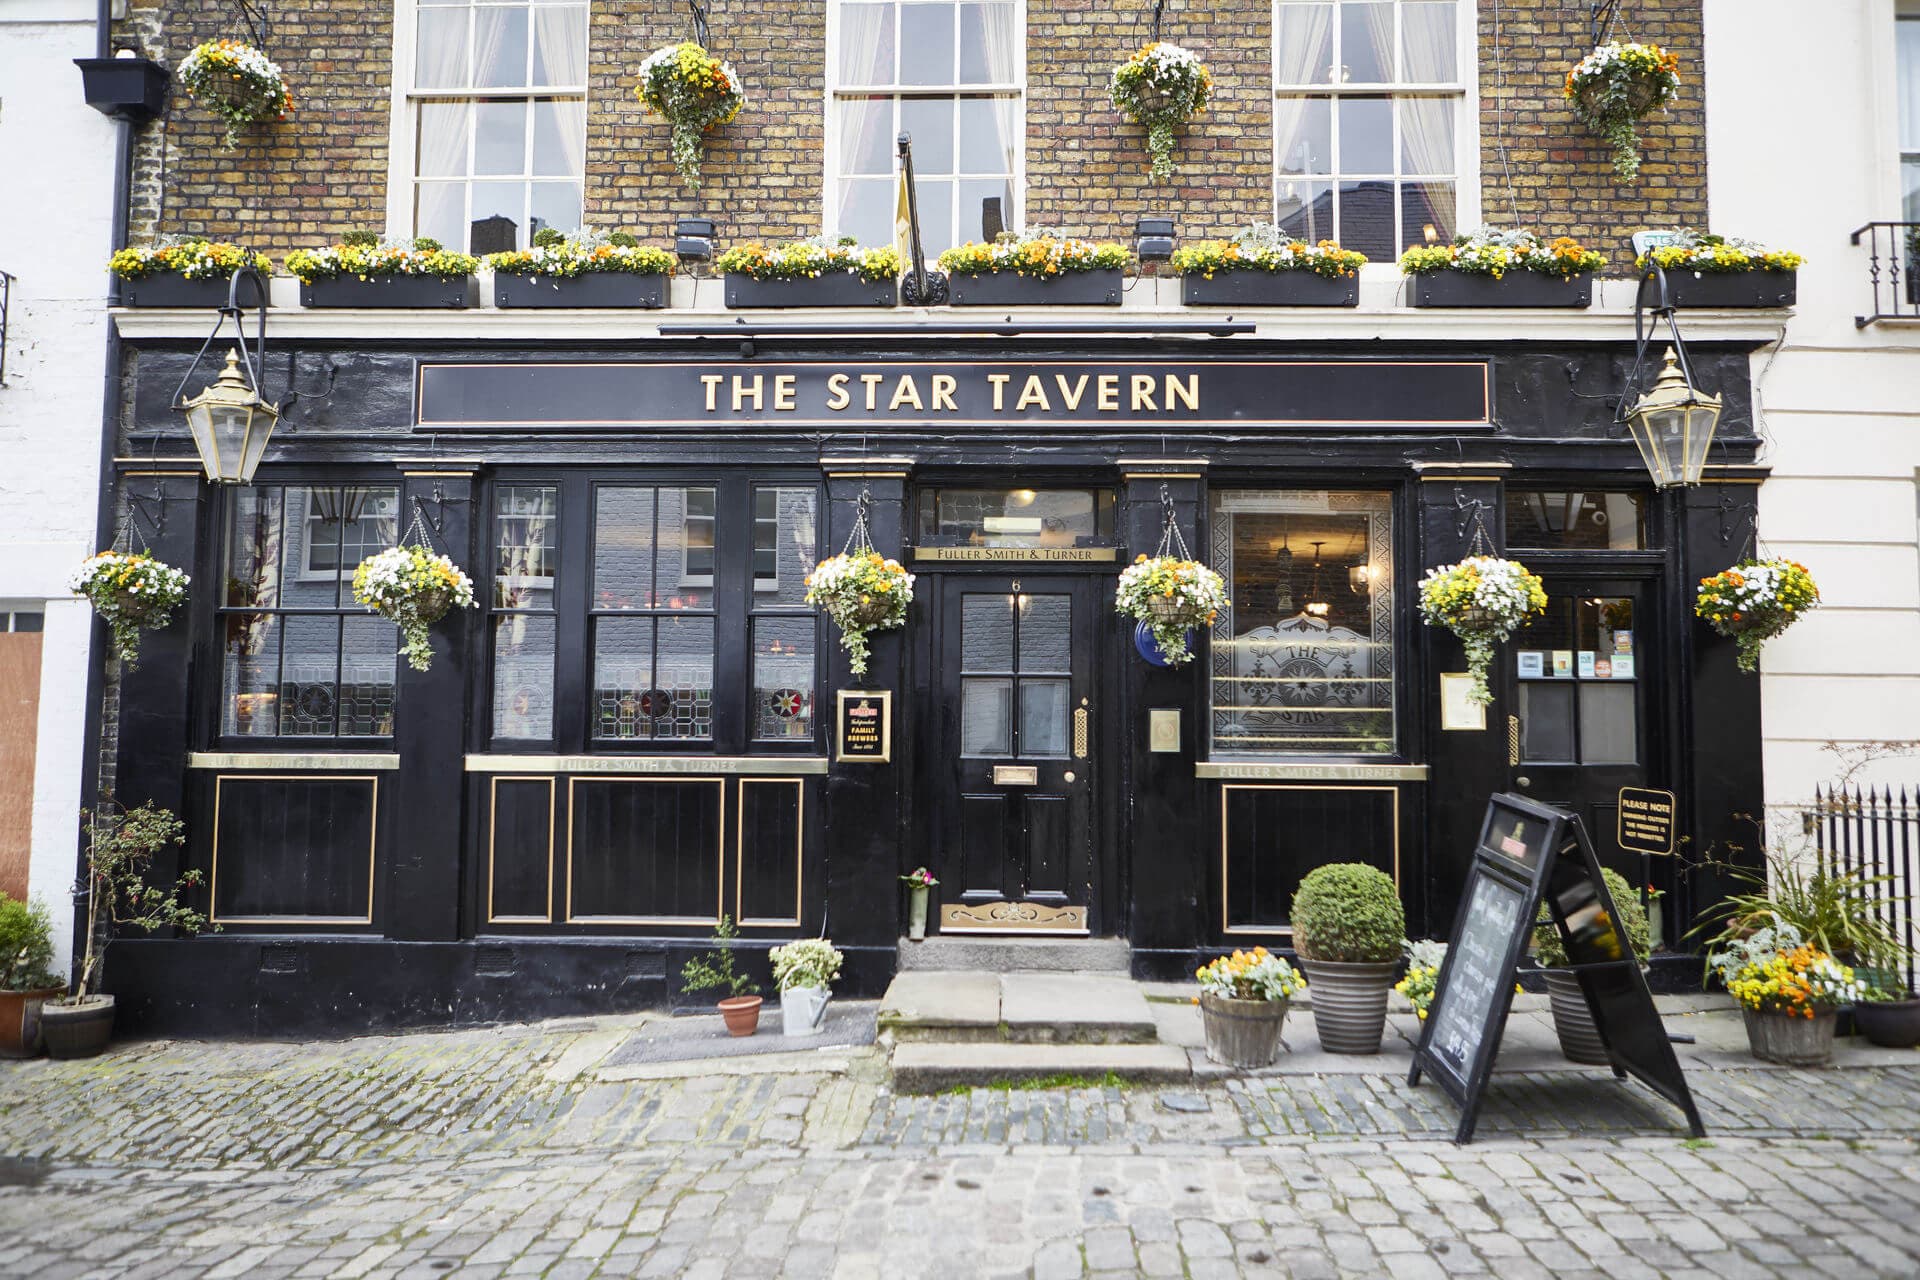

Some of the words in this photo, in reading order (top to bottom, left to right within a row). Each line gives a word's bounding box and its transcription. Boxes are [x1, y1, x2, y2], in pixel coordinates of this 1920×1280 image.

[700, 374, 796, 411] THE
[826, 373, 959, 411] STAR
[987, 374, 1200, 411] TAVERN
[937, 549, 981, 560] FULLER
[985, 549, 1025, 560] SMITH
[1029, 549, 1040, 560] &
[1044, 549, 1093, 560] TURNER
[1012, 578, 1021, 592] 6
[1286, 646, 1320, 659] THE
[559, 759, 609, 771] FULLER
[613, 759, 659, 771] SMITH
[664, 760, 673, 771] &
[681, 760, 737, 772] TURNER
[1219, 766, 1270, 777] FULLER
[1276, 767, 1323, 778] SMITH
[1327, 767, 1337, 778] &
[1347, 767, 1401, 778] TURNER
[1622, 799, 1648, 810] PLEASE
[1650, 802, 1670, 813] NOTE
